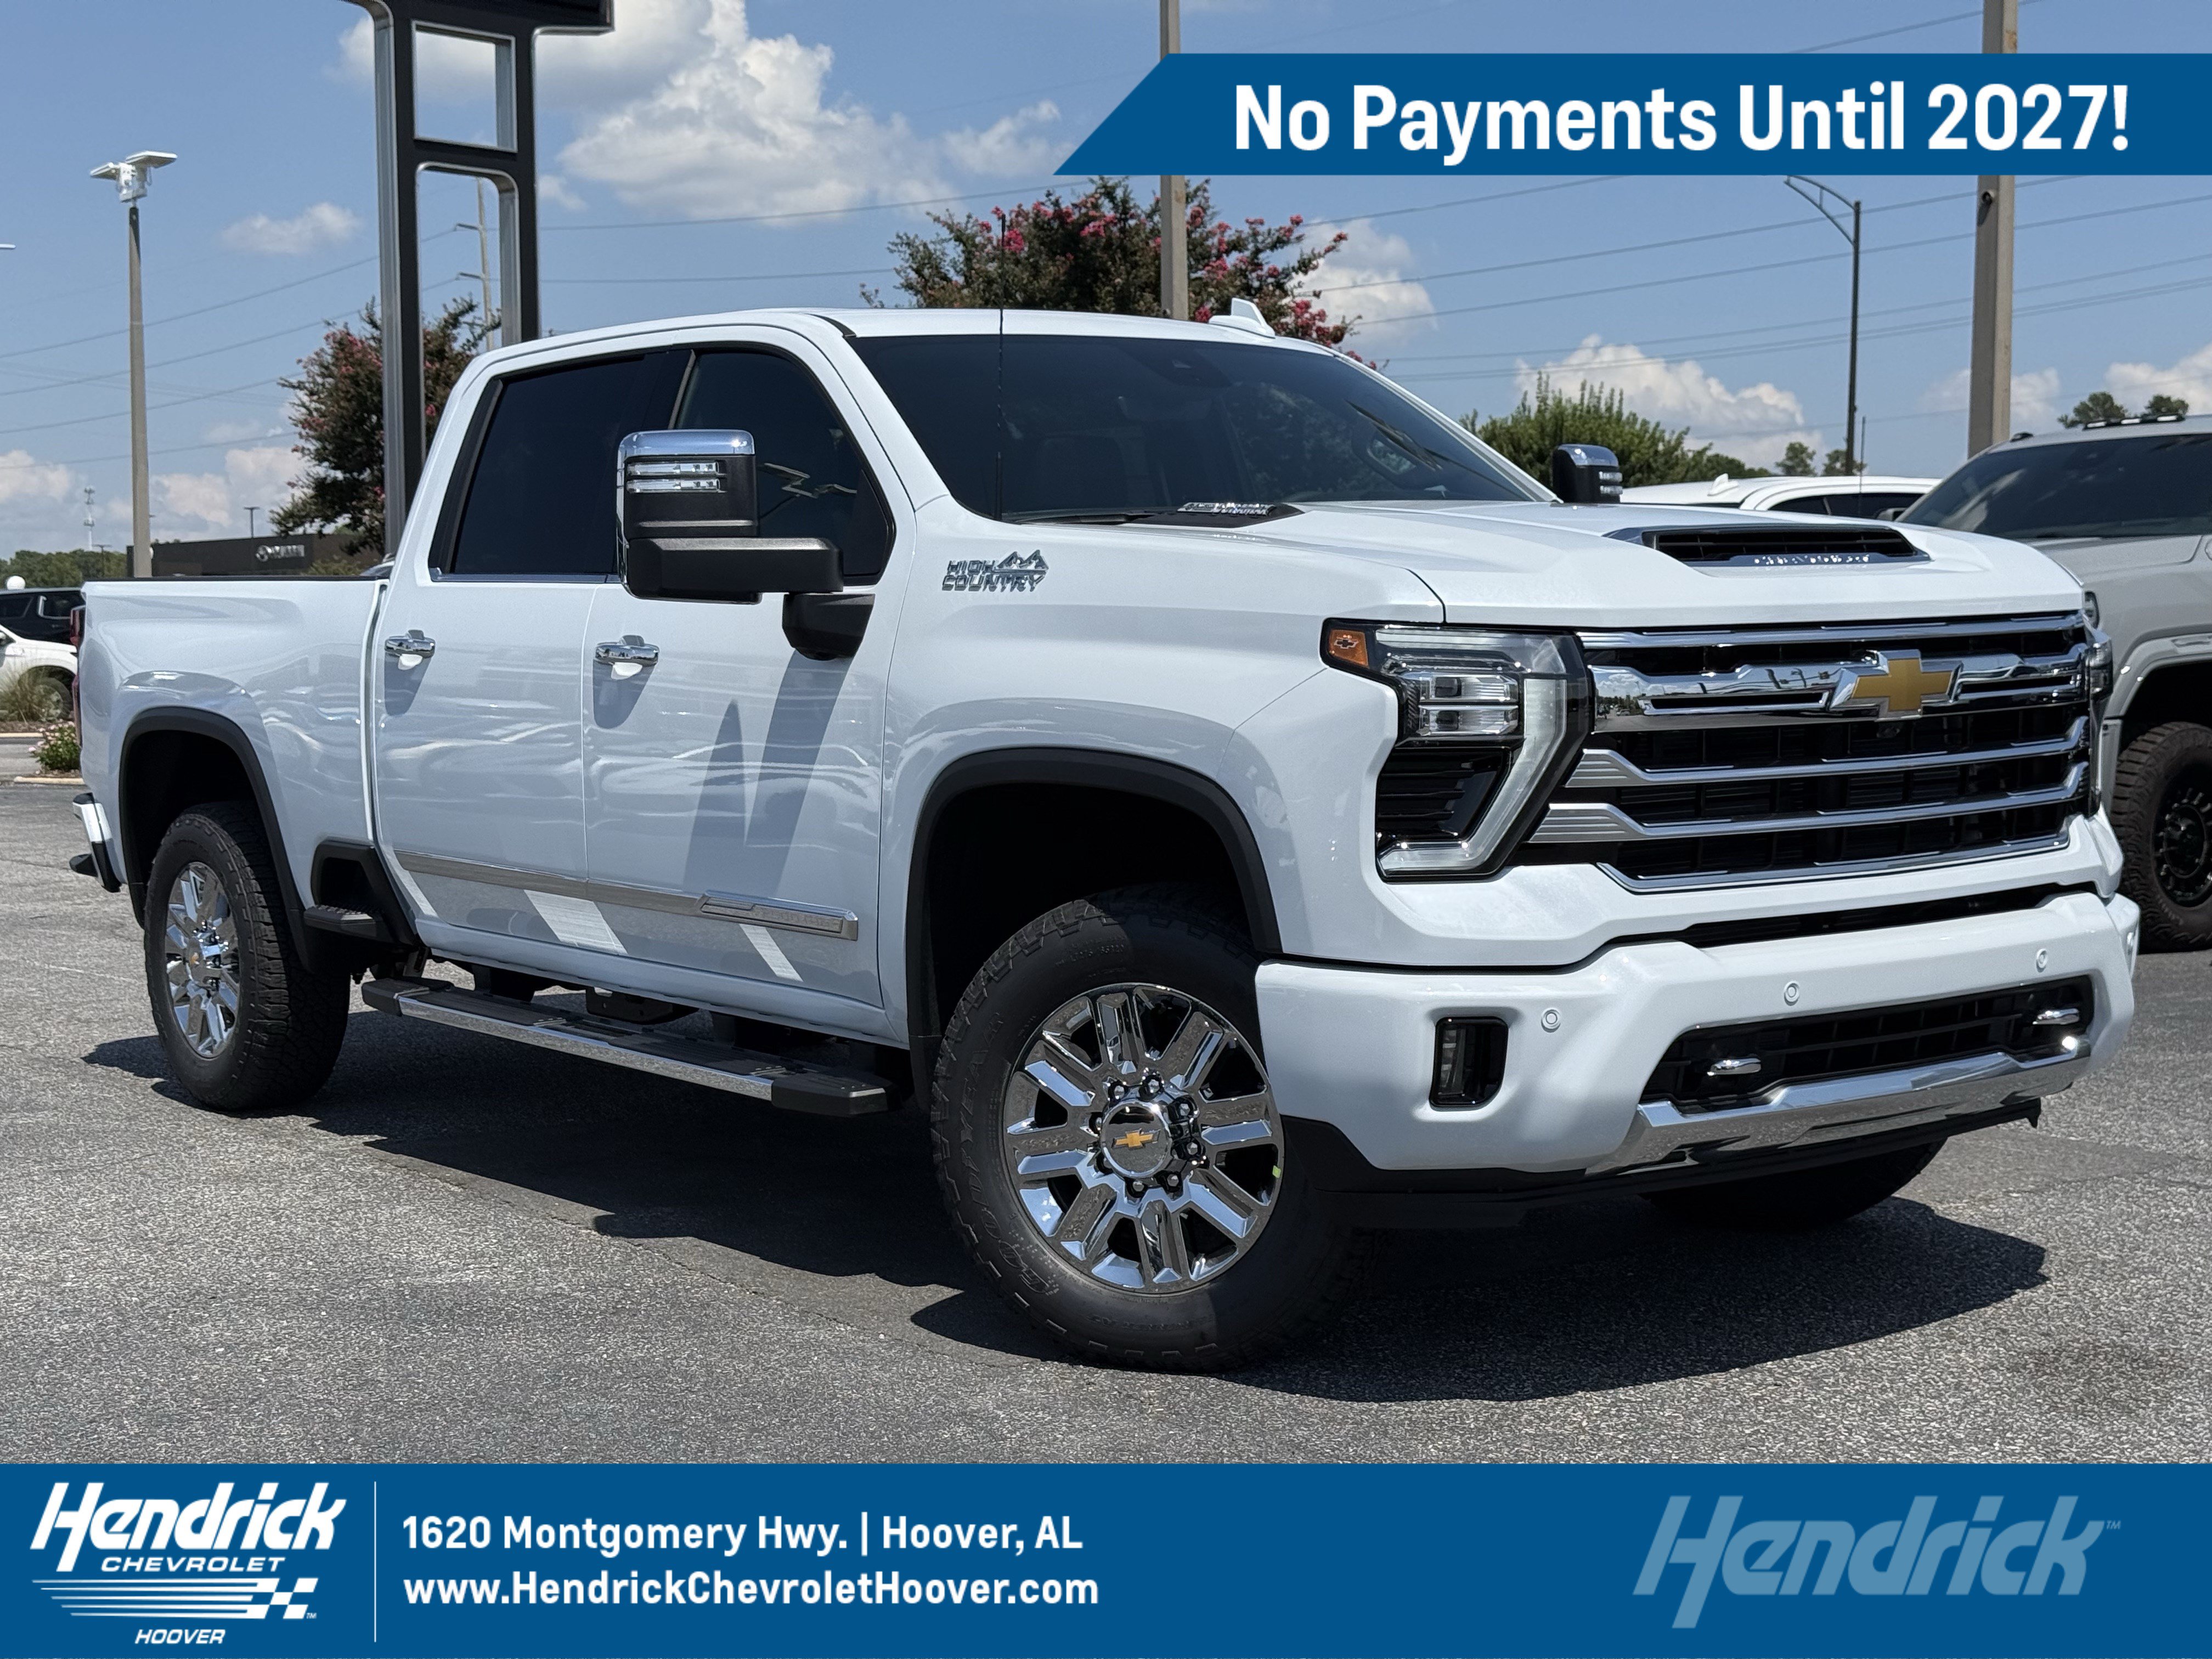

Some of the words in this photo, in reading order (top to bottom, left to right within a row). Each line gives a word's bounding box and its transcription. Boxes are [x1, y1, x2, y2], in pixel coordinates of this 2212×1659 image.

[947, 560, 996, 575] HIGH
[942, 574, 1046, 592] COUNTRY
[960, 1012, 1049, 1295] GOODYEAR
